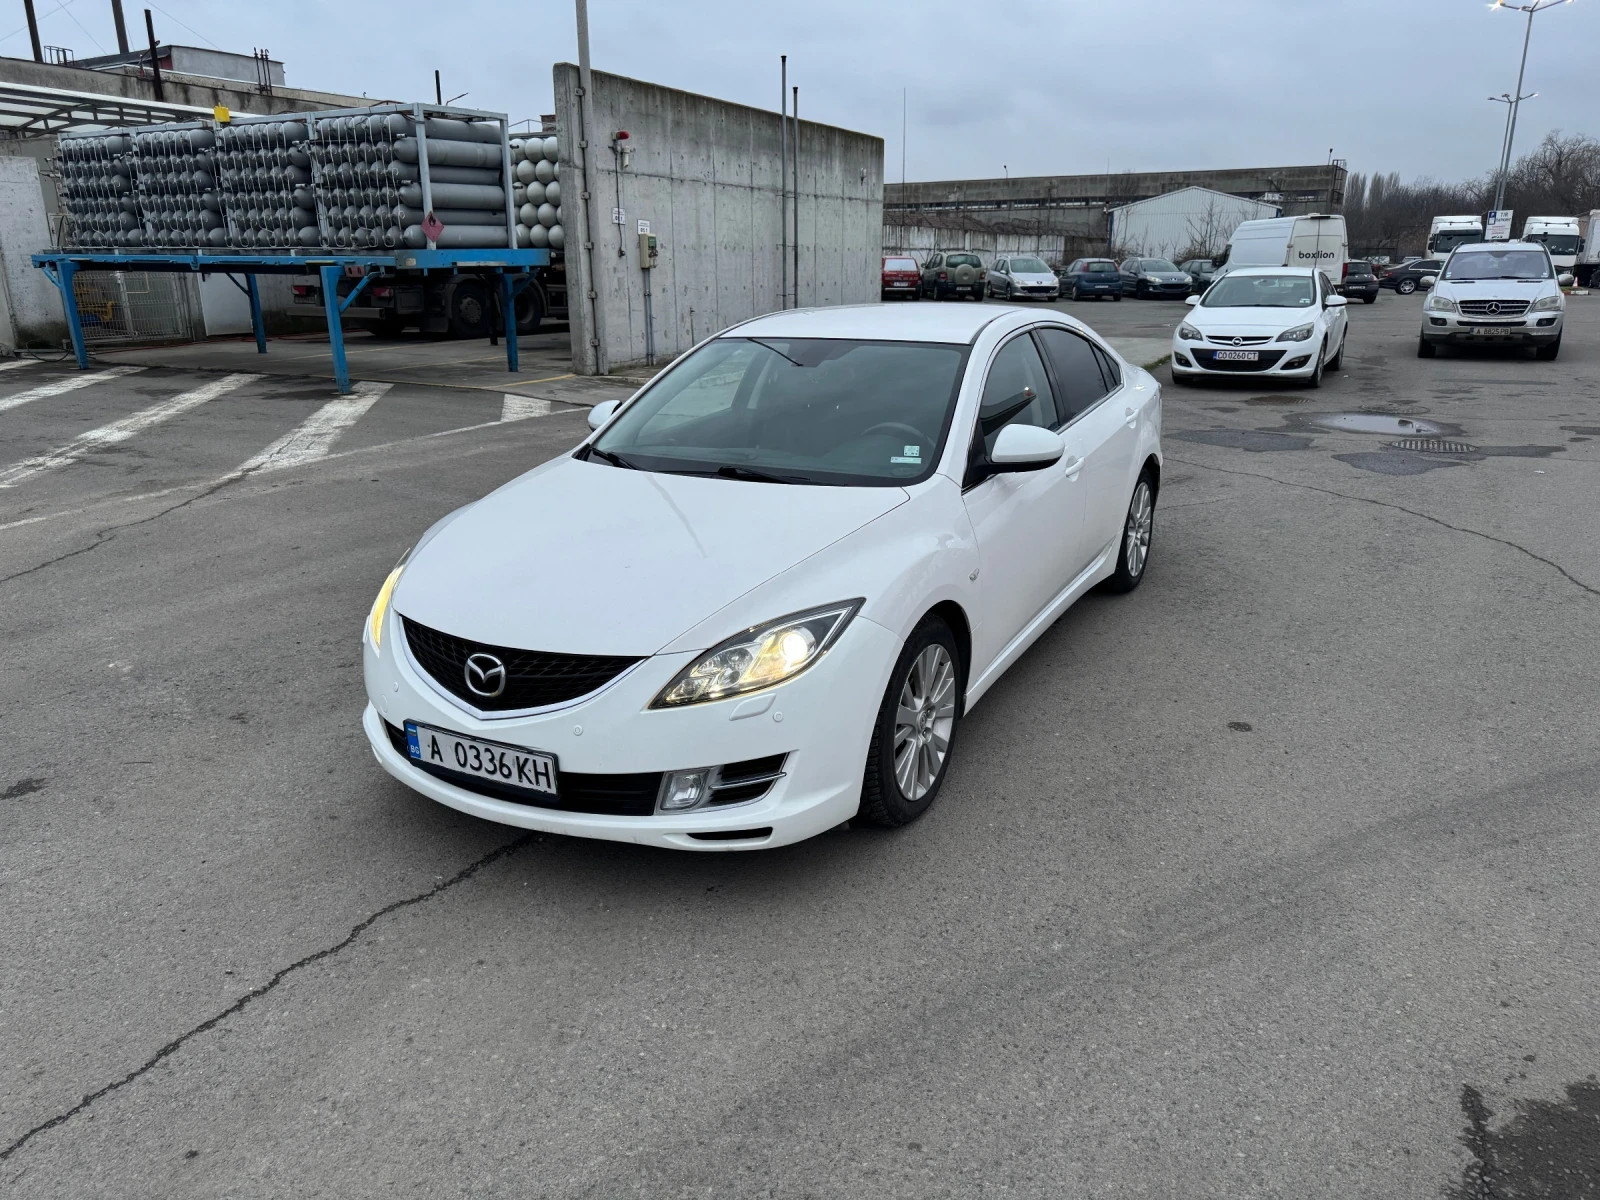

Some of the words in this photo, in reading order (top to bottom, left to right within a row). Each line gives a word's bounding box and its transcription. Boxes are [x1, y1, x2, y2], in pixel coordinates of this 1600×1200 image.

[1298, 250, 1335, 259] boxlion
[409, 744, 421, 755] BG
[430, 735, 443, 762] A
